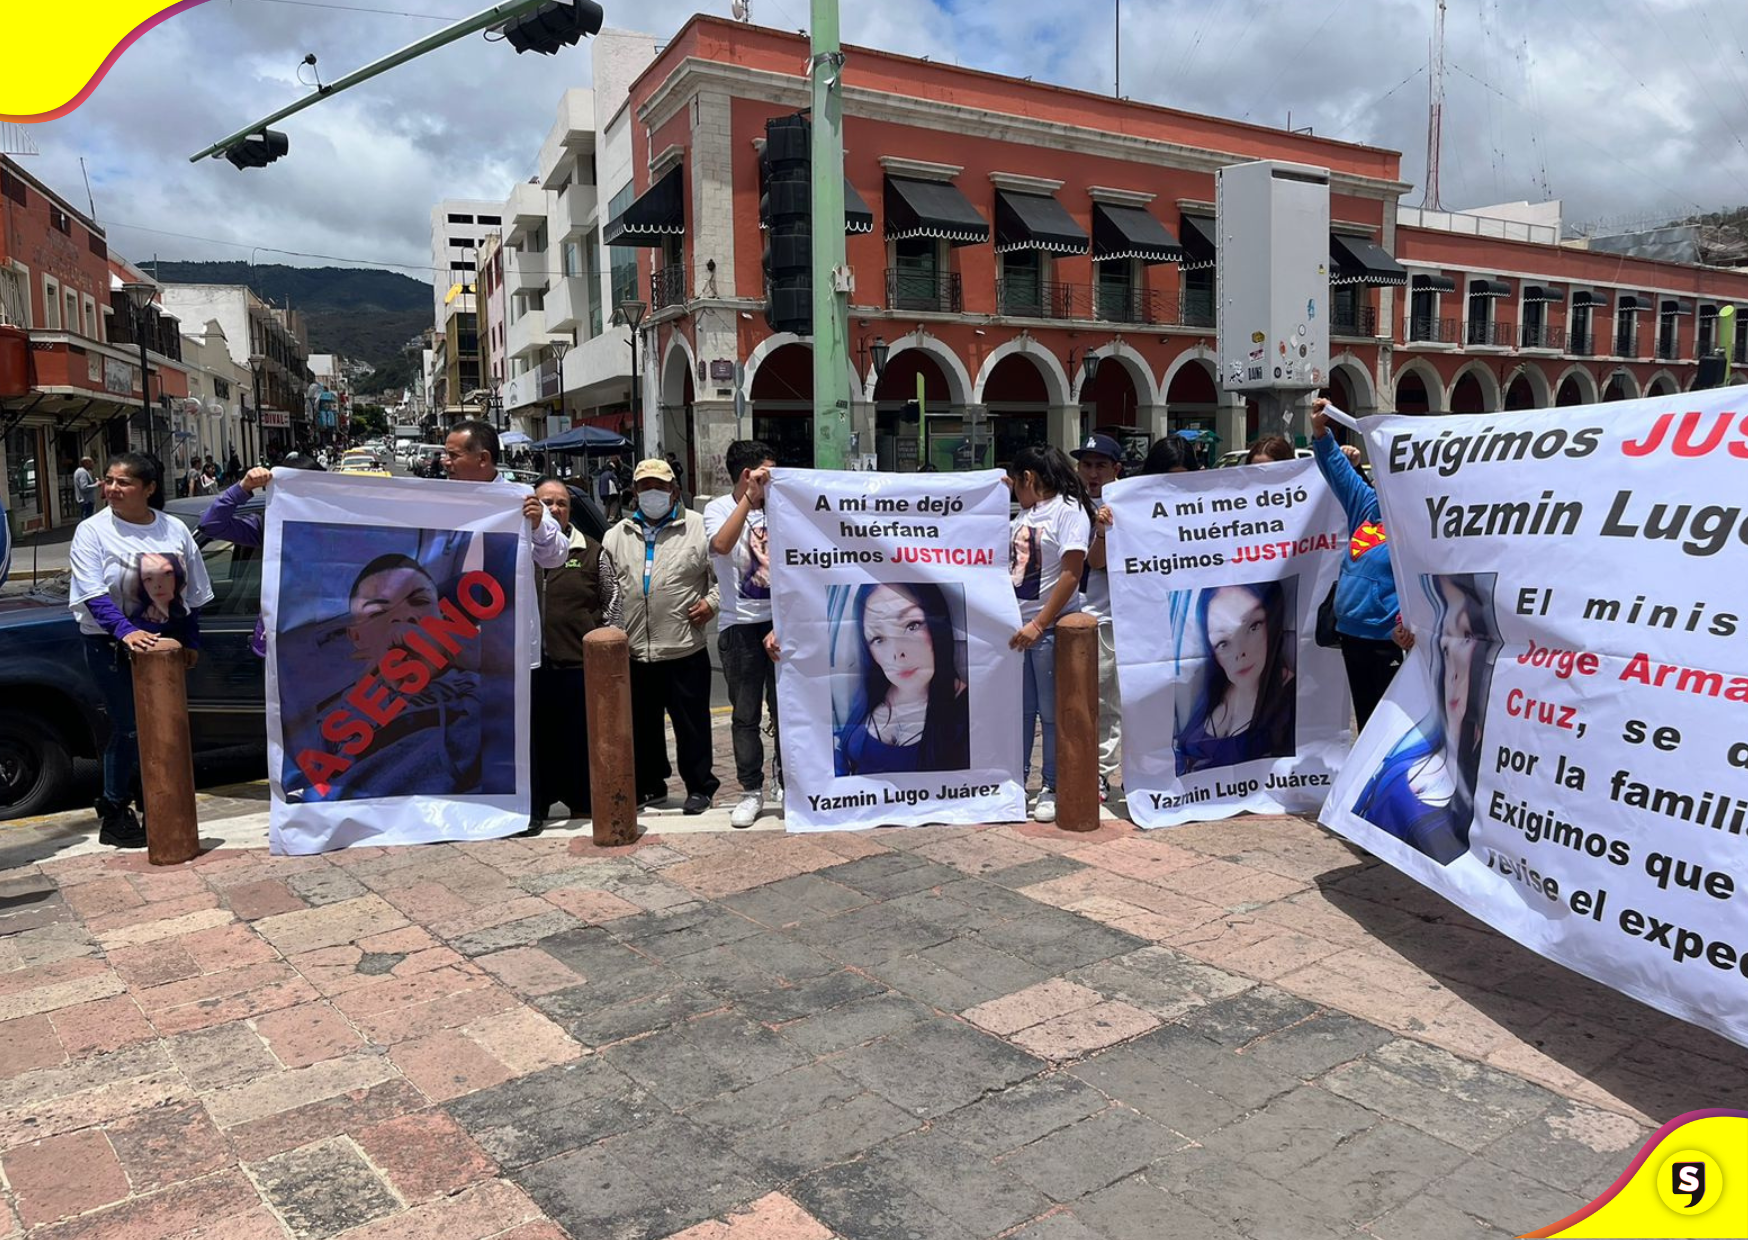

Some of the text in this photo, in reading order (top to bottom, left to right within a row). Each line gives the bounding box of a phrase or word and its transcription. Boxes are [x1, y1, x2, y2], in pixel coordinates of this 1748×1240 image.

[815, 495, 963, 516] A mí me dejó
[1152, 485, 1308, 518] A mí me dejó
[840, 521, 939, 538] huérfana
[1178, 519, 1285, 542] huérfana
[1425, 490, 1748, 556] Yazmin Lug
[785, 547, 994, 568] Exigimos JUSTICIA!
[1125, 533, 1338, 575] Exigimos JUSTICIA!
[1516, 588, 1553, 616] El
[1517, 639, 1600, 679] Jorge
[295, 569, 507, 798] ASESINO
[1506, 688, 1682, 751] Cruz, se
[808, 784, 1000, 812] Yazmin Lugo Juárez
[1150, 772, 1330, 810] Yazmin Lugo Juárez
[1496, 745, 1748, 837] por la famili
[1489, 790, 1735, 901] Exigimos que
[1486, 848, 1748, 980] revise el expe
